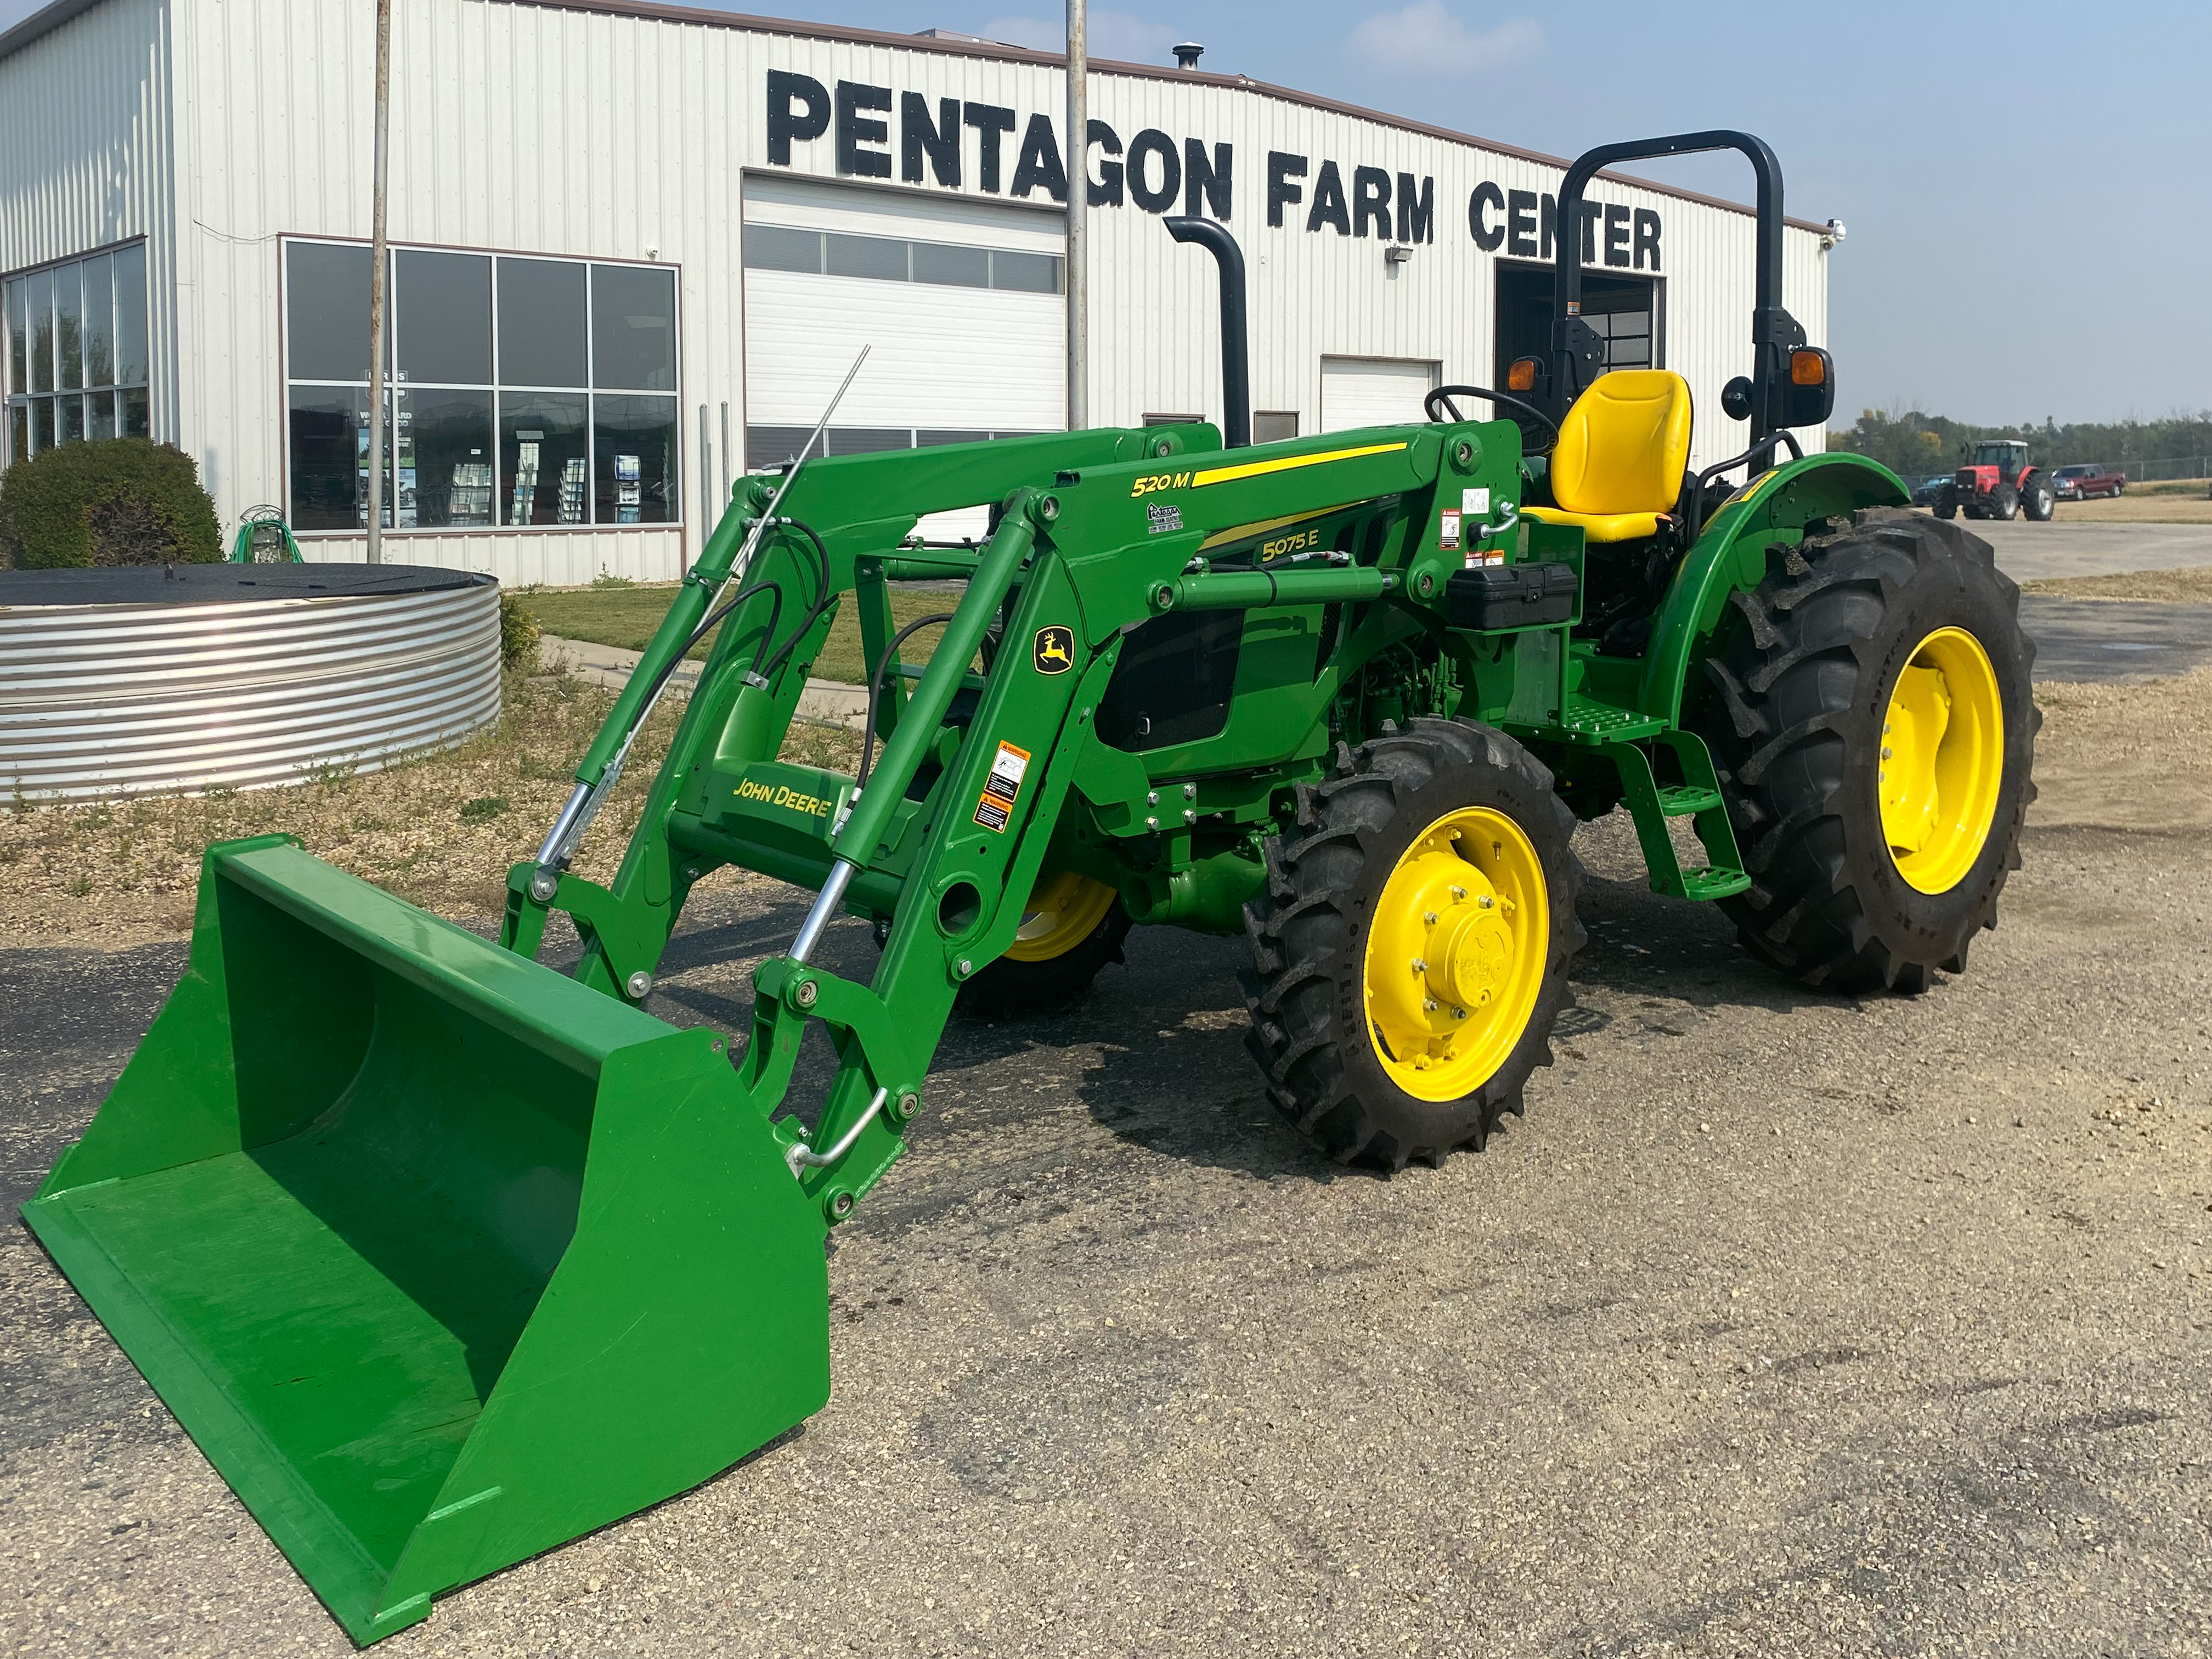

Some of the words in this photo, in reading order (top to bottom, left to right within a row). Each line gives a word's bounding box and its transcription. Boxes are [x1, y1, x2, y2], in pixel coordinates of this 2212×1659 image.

[768, 68, 1233, 221] PENTAGON
[1267, 150, 1434, 245] FARM
[1469, 181, 1661, 271] CENTER
[1130, 474, 1171, 498] 520
[1172, 471, 1191, 489] M
[1262, 533, 1306, 562] 5075
[1308, 529, 1319, 546] E
[733, 777, 776, 803] JOHN
[773, 786, 832, 818] DEERE
